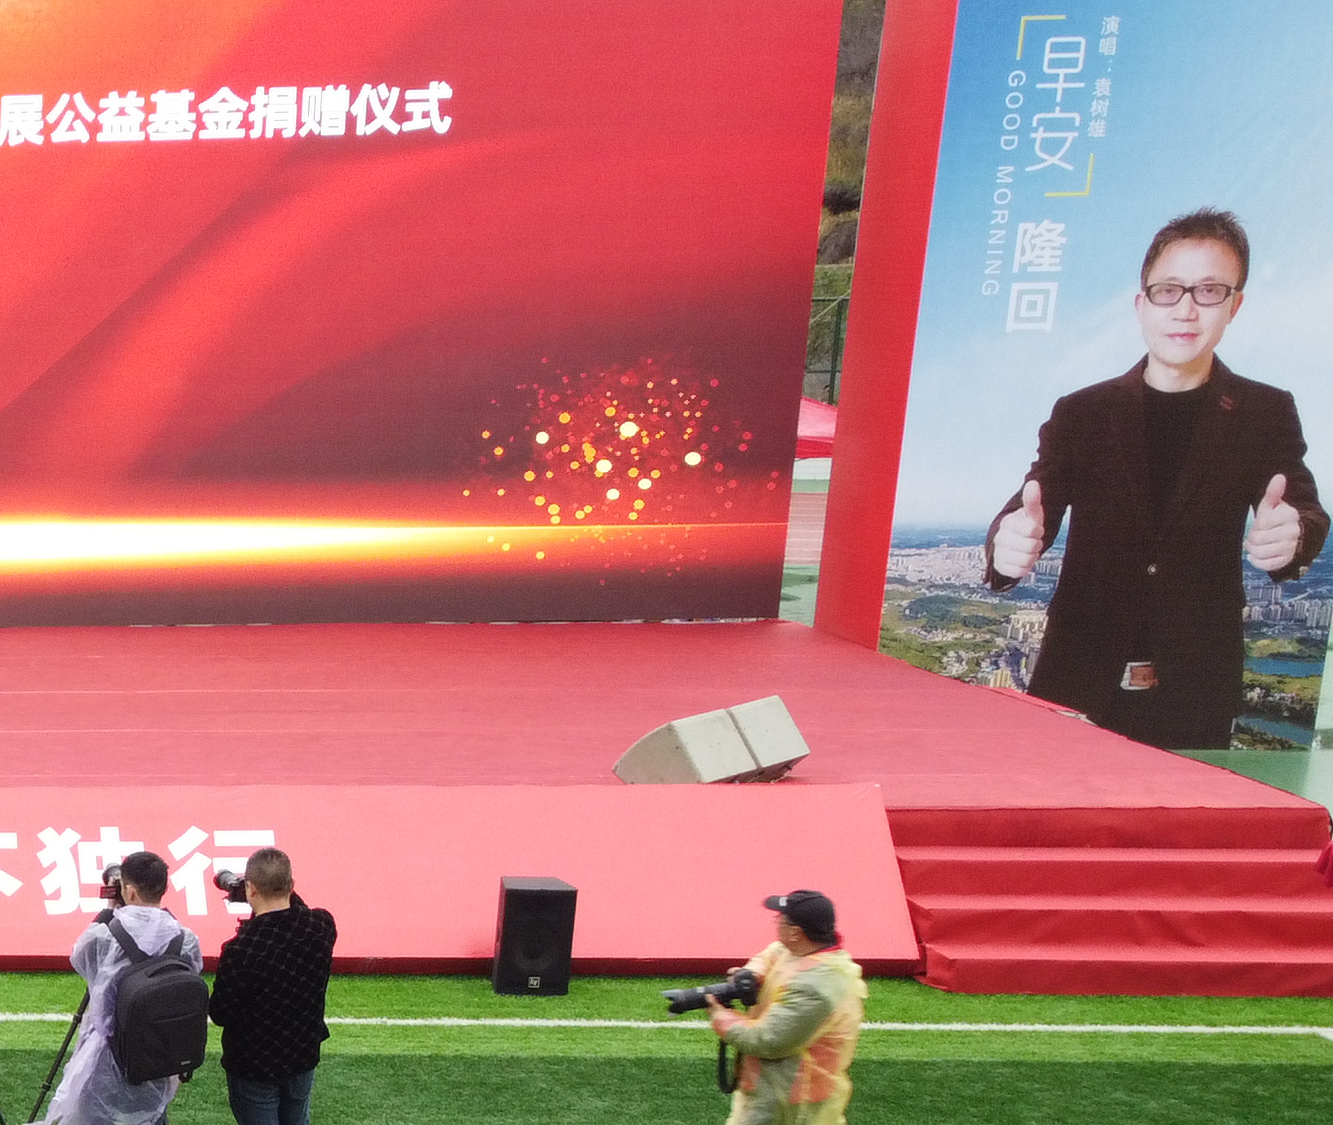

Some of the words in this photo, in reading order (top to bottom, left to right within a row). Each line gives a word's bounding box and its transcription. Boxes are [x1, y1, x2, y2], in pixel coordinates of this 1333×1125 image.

[1000, 70, 1026, 151] GOOD
[1025, 36, 1086, 172] 早安
[981, 166, 1015, 296] MORNING
[1005, 219, 1067, 333] 隆回
